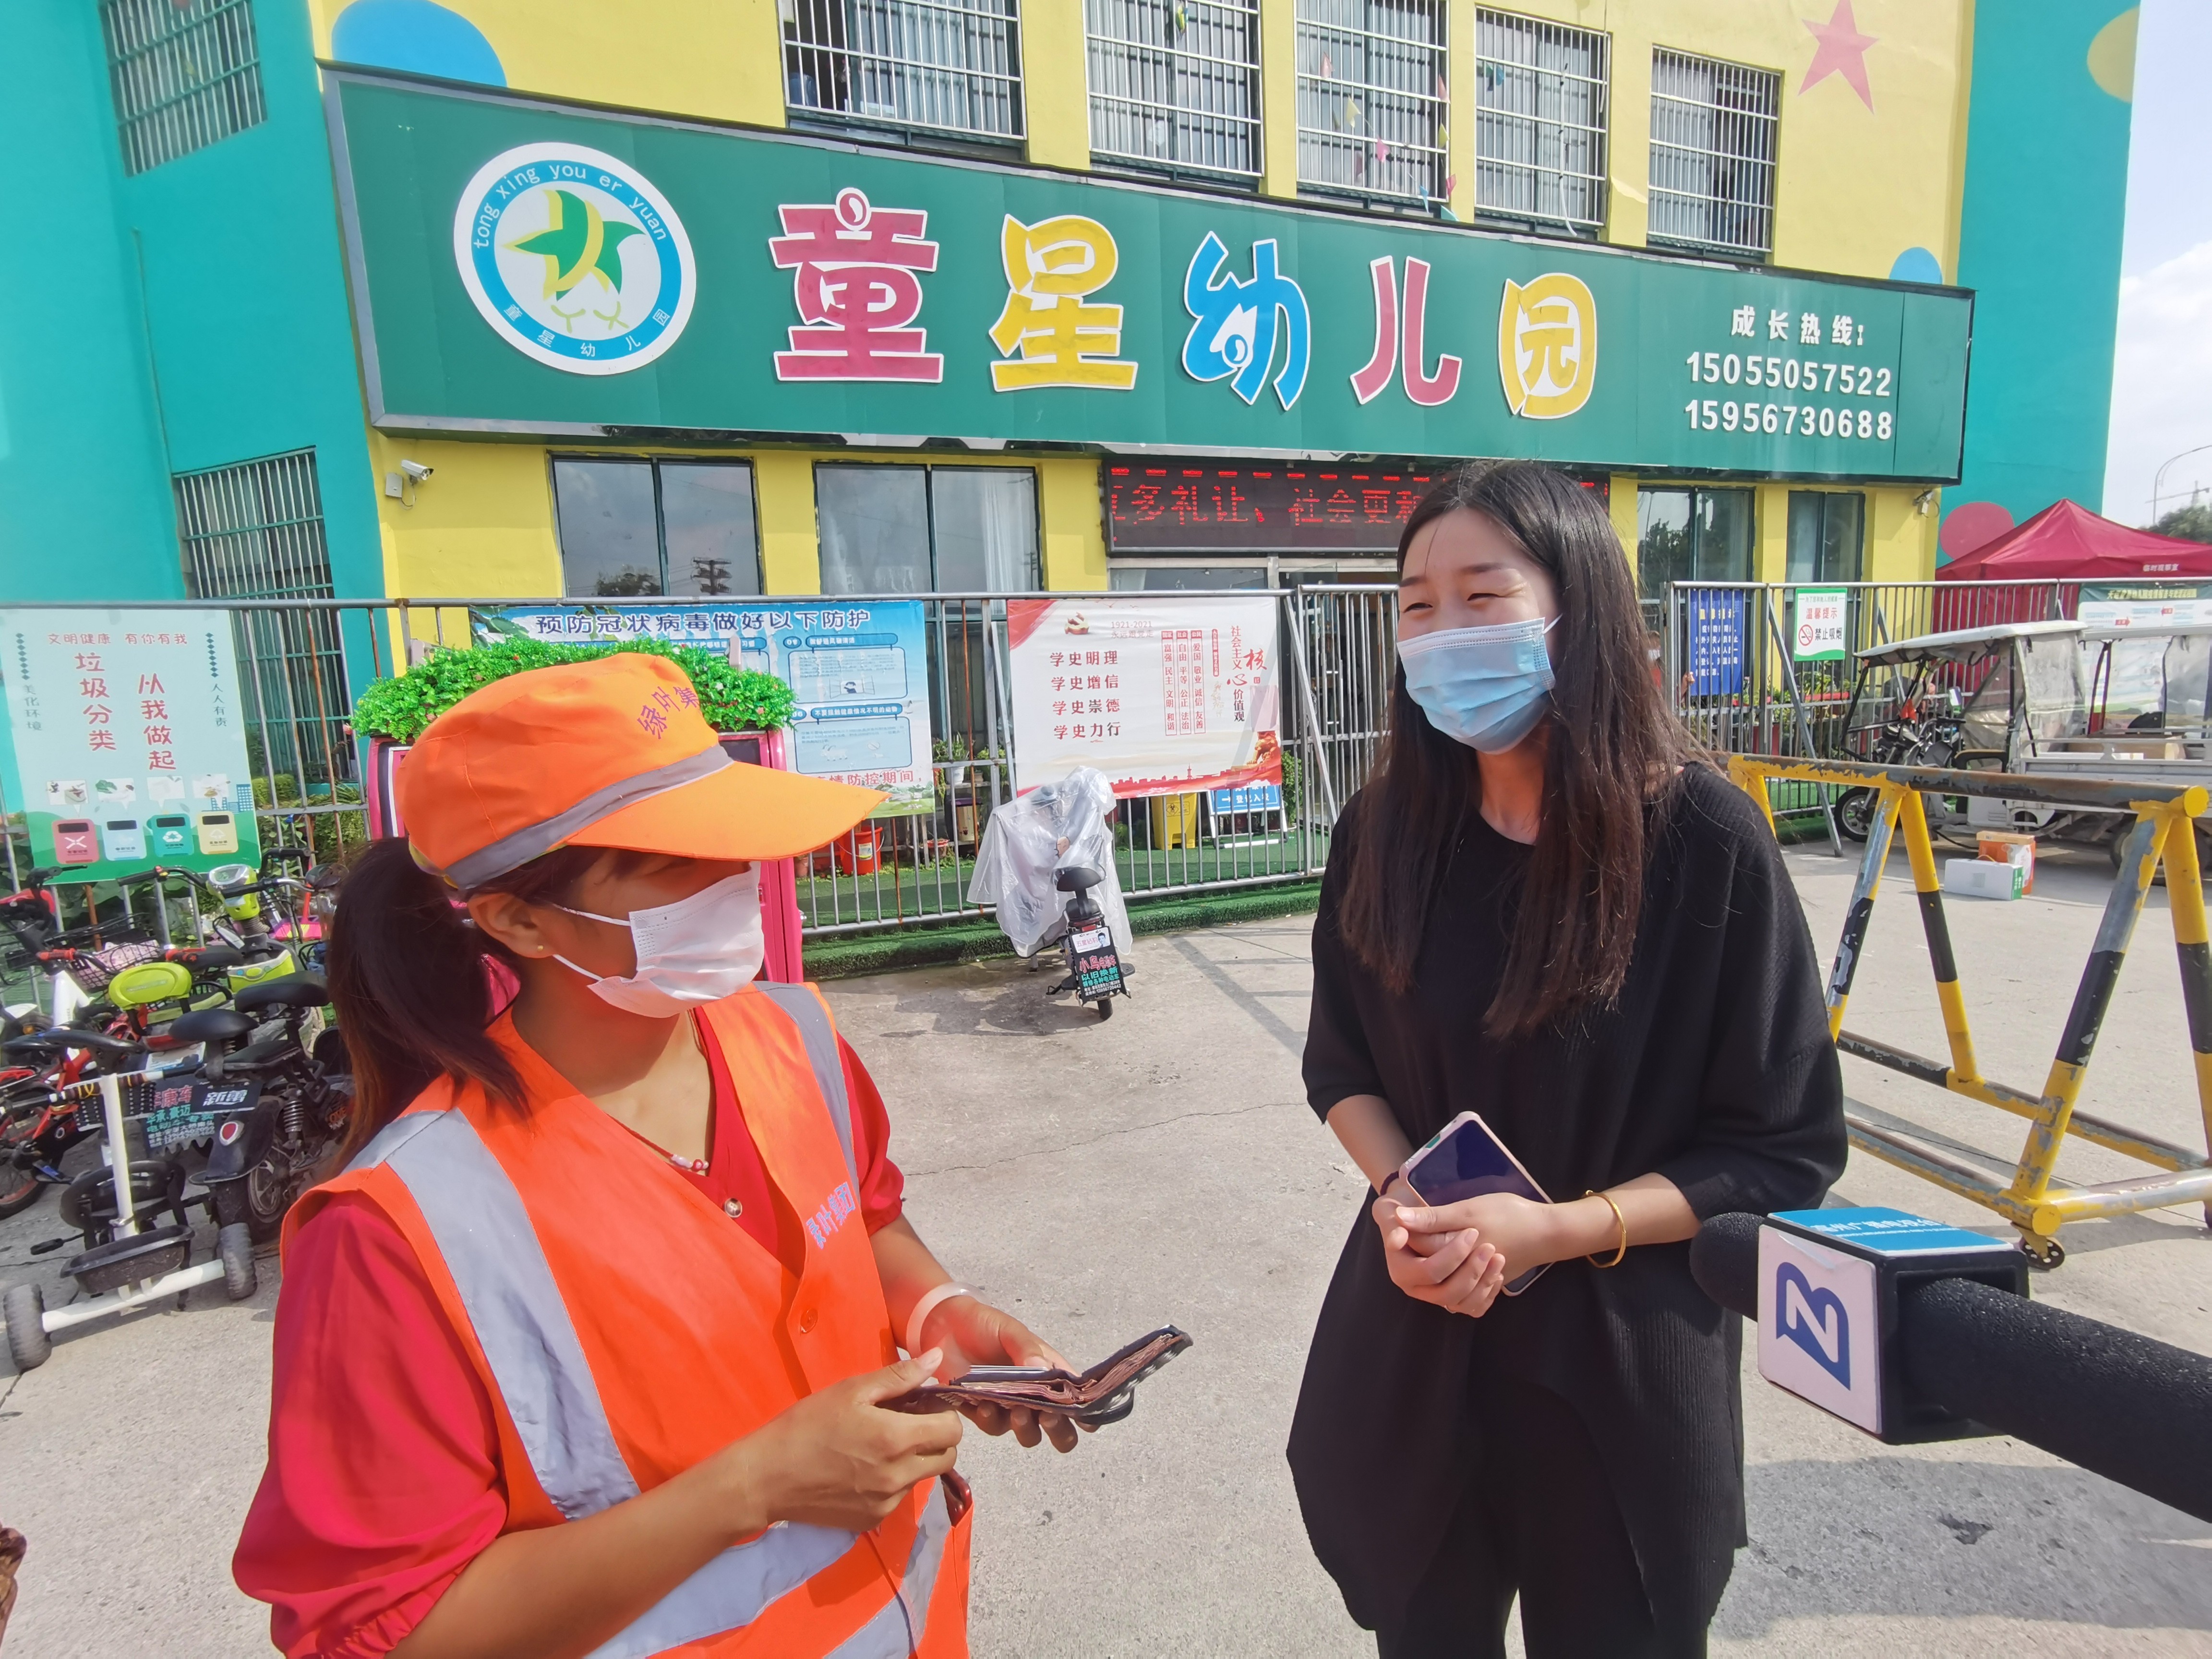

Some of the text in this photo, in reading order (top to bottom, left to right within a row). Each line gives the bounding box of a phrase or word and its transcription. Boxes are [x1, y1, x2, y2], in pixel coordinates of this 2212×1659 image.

[473, 164, 667, 248] tong xing you er yuan
[769, 187, 1597, 420] 童星幼儿园
[504, 304, 670, 357] 童星幼儿园
[1686, 351, 1891, 397] 15055057522
[1685, 399, 1892, 440] 15956730688
[536, 610, 870, 634] 预防冠状病毒做好以下防护
[1805, 607, 1838, 619] 温馨提示
[48, 633, 187, 645] 文明健康 有你有我
[1111, 630, 1154, 638] 永远跟党走
[1231, 625, 1243, 670] 社会主义
[1815, 627, 1842, 641] 禁止吸烟
[1049, 650, 1118, 667] 学史明理
[1051, 674, 1119, 691] 学史增信
[23, 684, 43, 731] 美化环境
[74, 652, 117, 752] 垃圾分类
[210, 683, 227, 727] 人人有责
[637, 686, 700, 740] 绿叶集
[1052, 698, 1120, 716] 学史崇德
[1233, 689, 1245, 722] 价值观
[138, 672, 177, 771] 从我做起
[1054, 721, 1121, 740] 学史力行
[1081, 966, 1118, 981] 以旧换新
